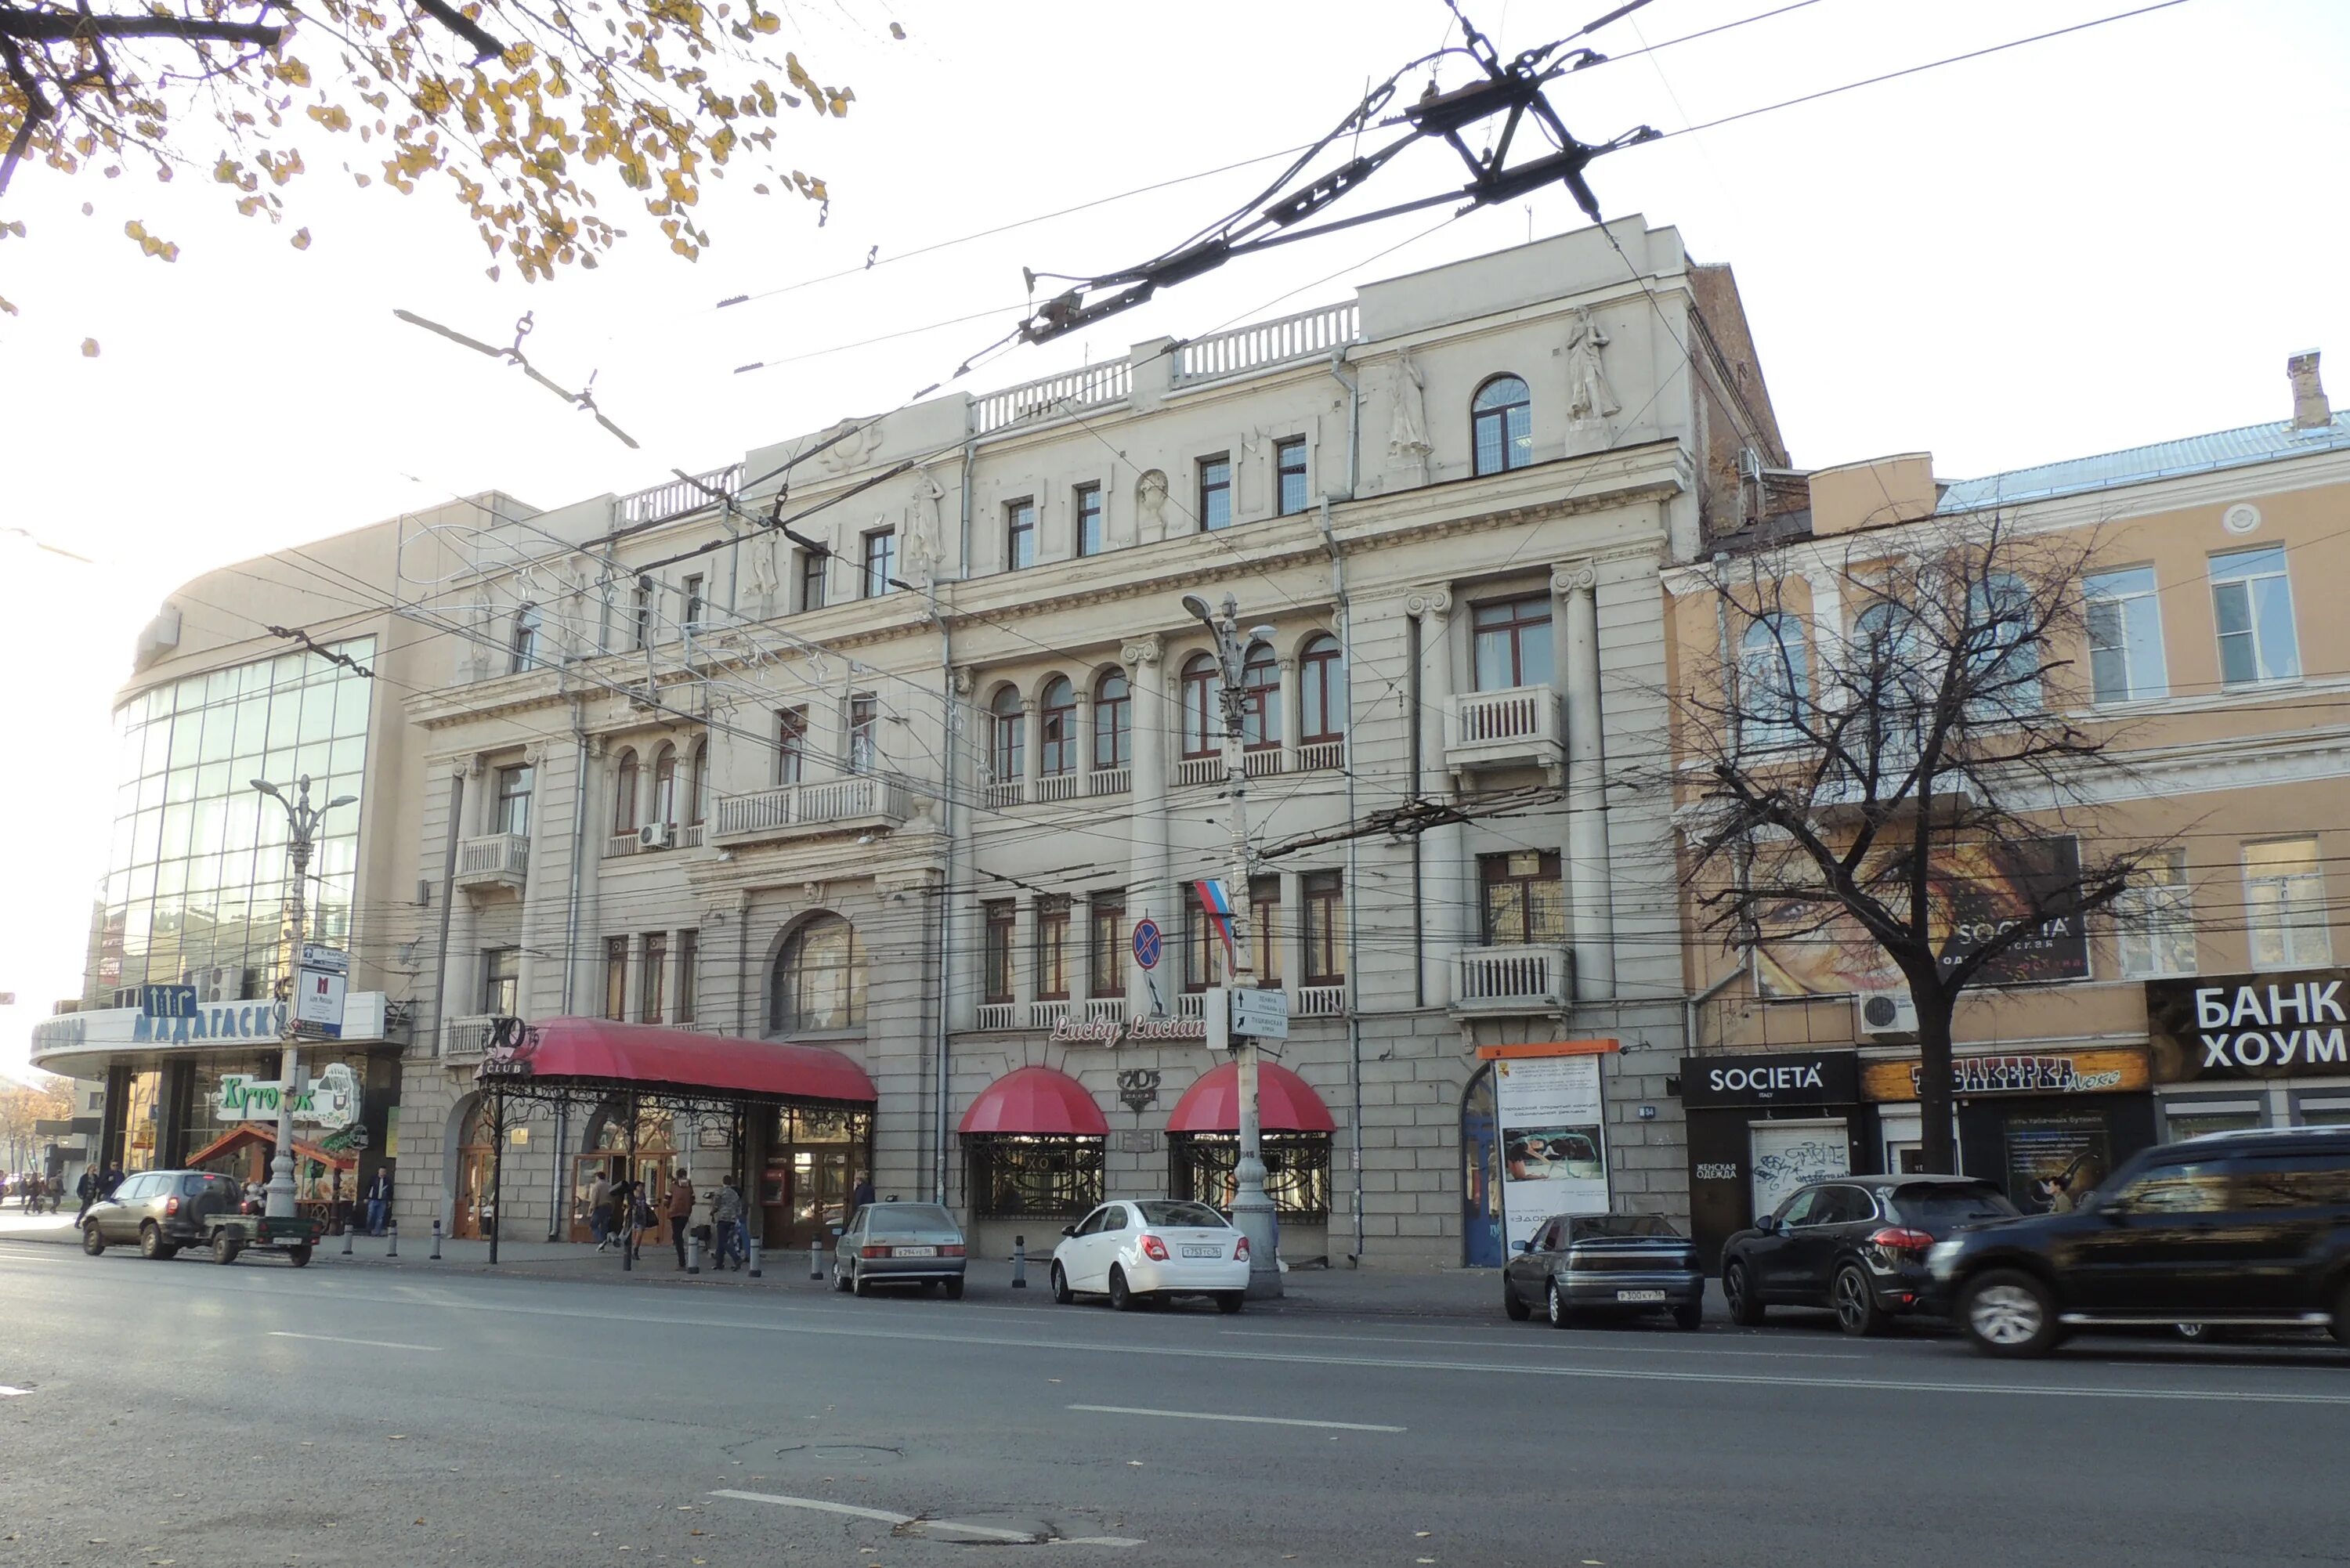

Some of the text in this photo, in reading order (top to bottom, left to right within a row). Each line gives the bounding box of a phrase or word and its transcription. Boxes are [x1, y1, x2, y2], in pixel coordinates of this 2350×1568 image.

[2196, 980, 2348, 1029] БАНК
[132, 1006, 287, 1046] МАДАГАСКА
[1050, 1014, 1123, 1048] Lucky
[2200, 1028, 2348, 1068] ХОУМ
[486, 1064, 522, 1074] CLUB
[1911, 1056, 2073, 1093] ТБАКЕРКА
[1697, 1170, 1737, 1180] ОДЕЖДА
